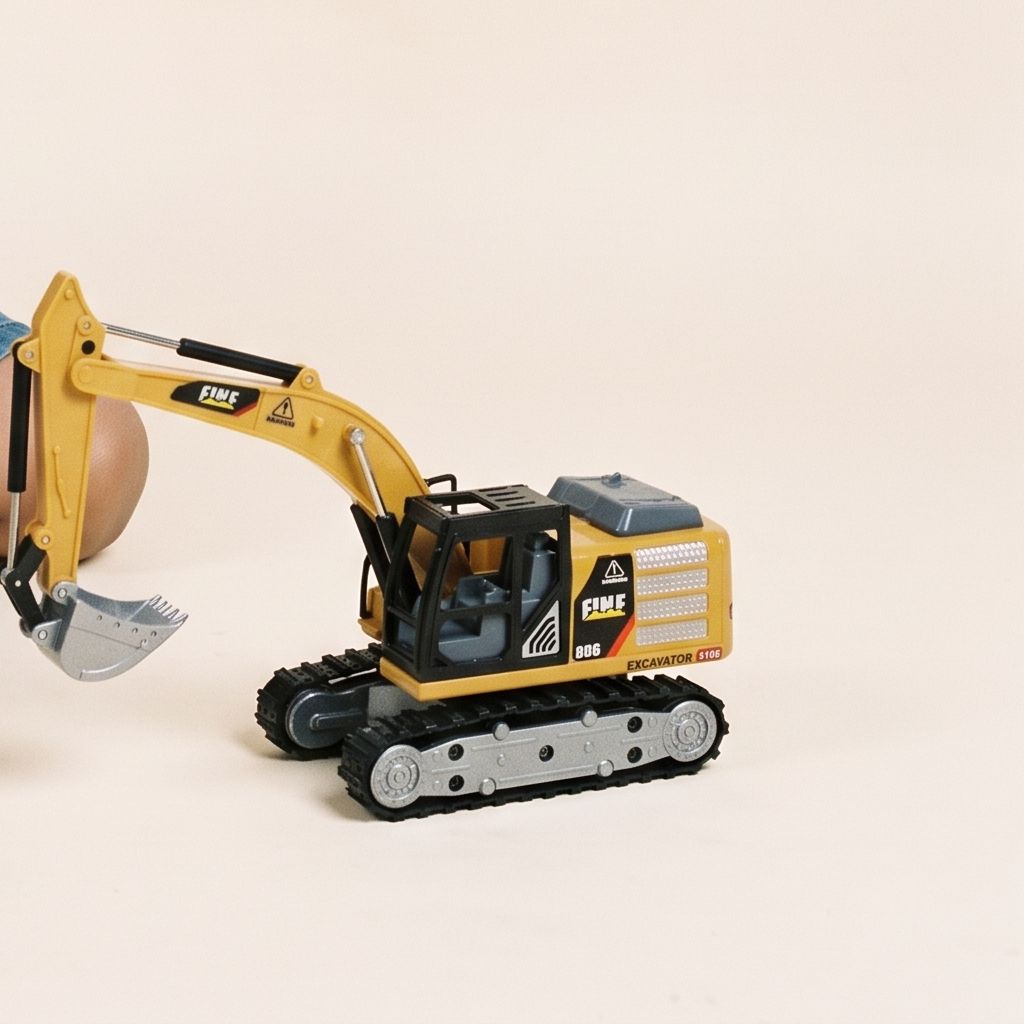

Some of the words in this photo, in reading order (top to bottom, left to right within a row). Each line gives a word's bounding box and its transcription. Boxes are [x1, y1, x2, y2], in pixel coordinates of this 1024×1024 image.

[198, 385, 240, 405] FINE
[576, 643, 601, 659] 806
[627, 653, 693, 671] EXCAVATOR
